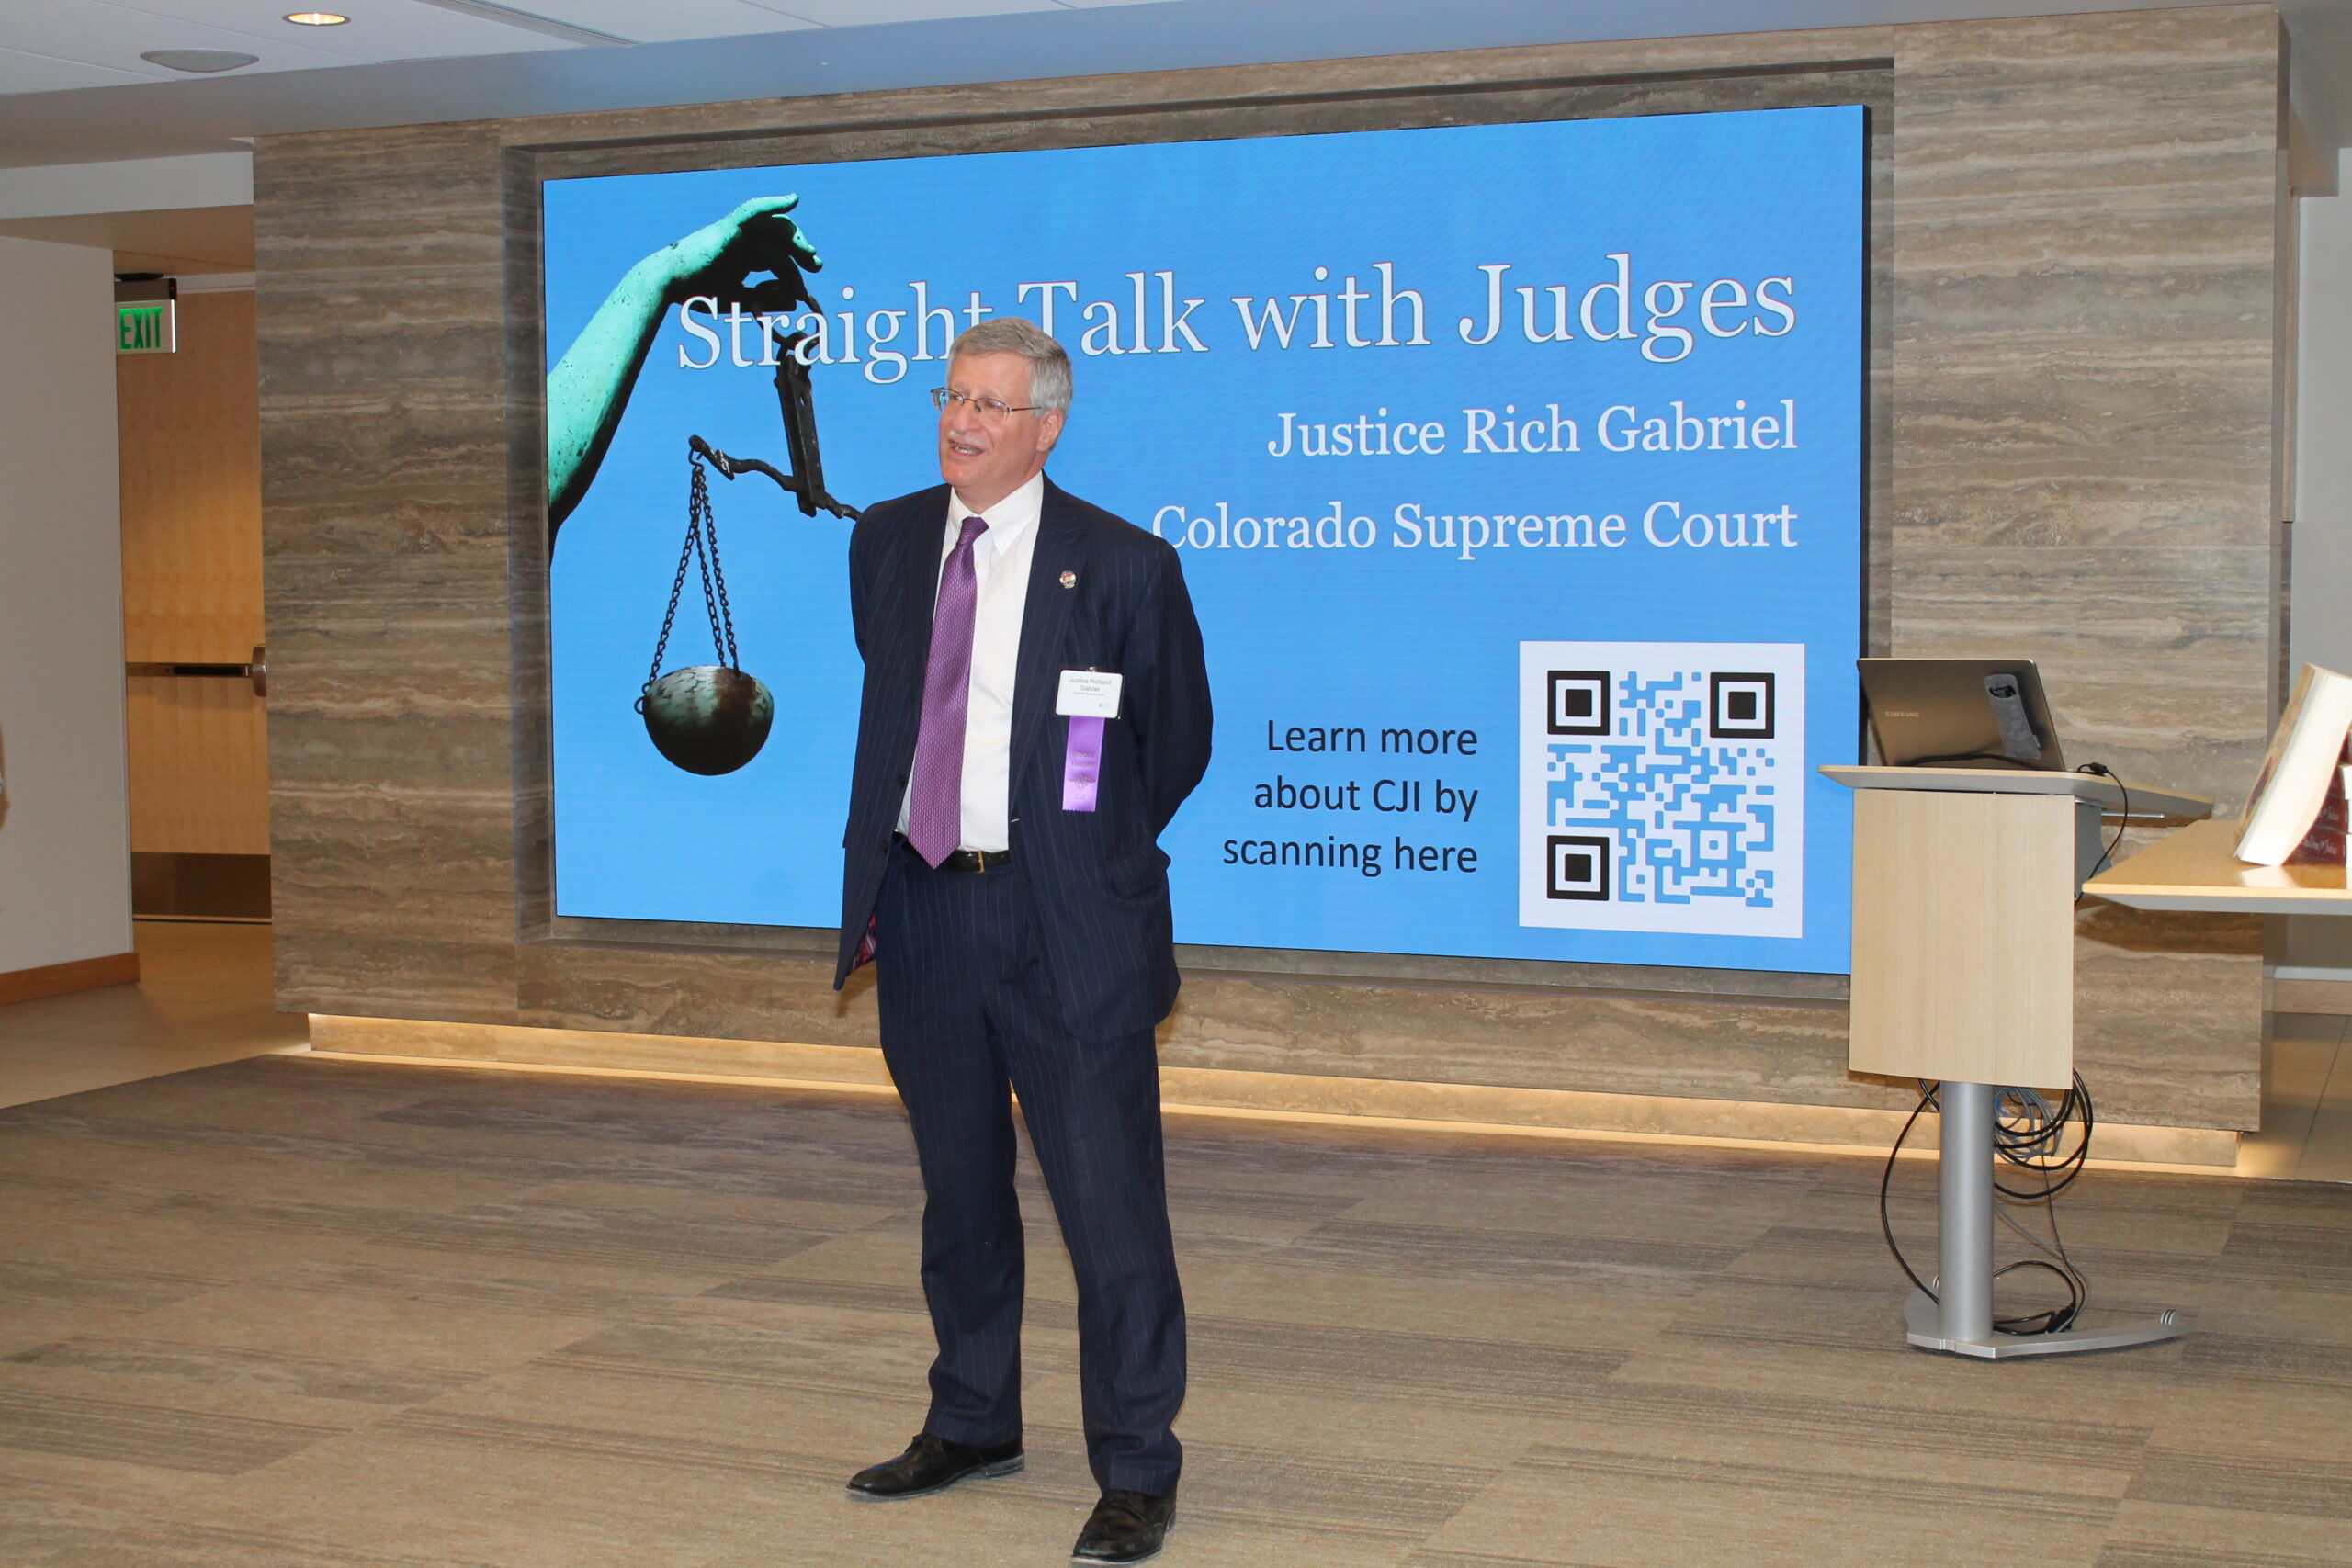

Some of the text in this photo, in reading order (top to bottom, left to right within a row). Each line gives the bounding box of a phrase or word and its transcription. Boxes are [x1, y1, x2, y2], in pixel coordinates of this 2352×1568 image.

[119, 306, 163, 350] EXIT
[1018, 270, 1209, 356] Talk
[1232, 263, 1431, 350] with
[1458, 252, 1796, 365] Judges
[1267, 398, 1799, 457] Justice Rich Gabriel
[1152, 500, 1799, 561] Colorado Supreme Court
[1268, 719, 1478, 756] Learn more
[1254, 774, 1478, 823] about CJI by
[1223, 836, 1478, 878] scanning here
